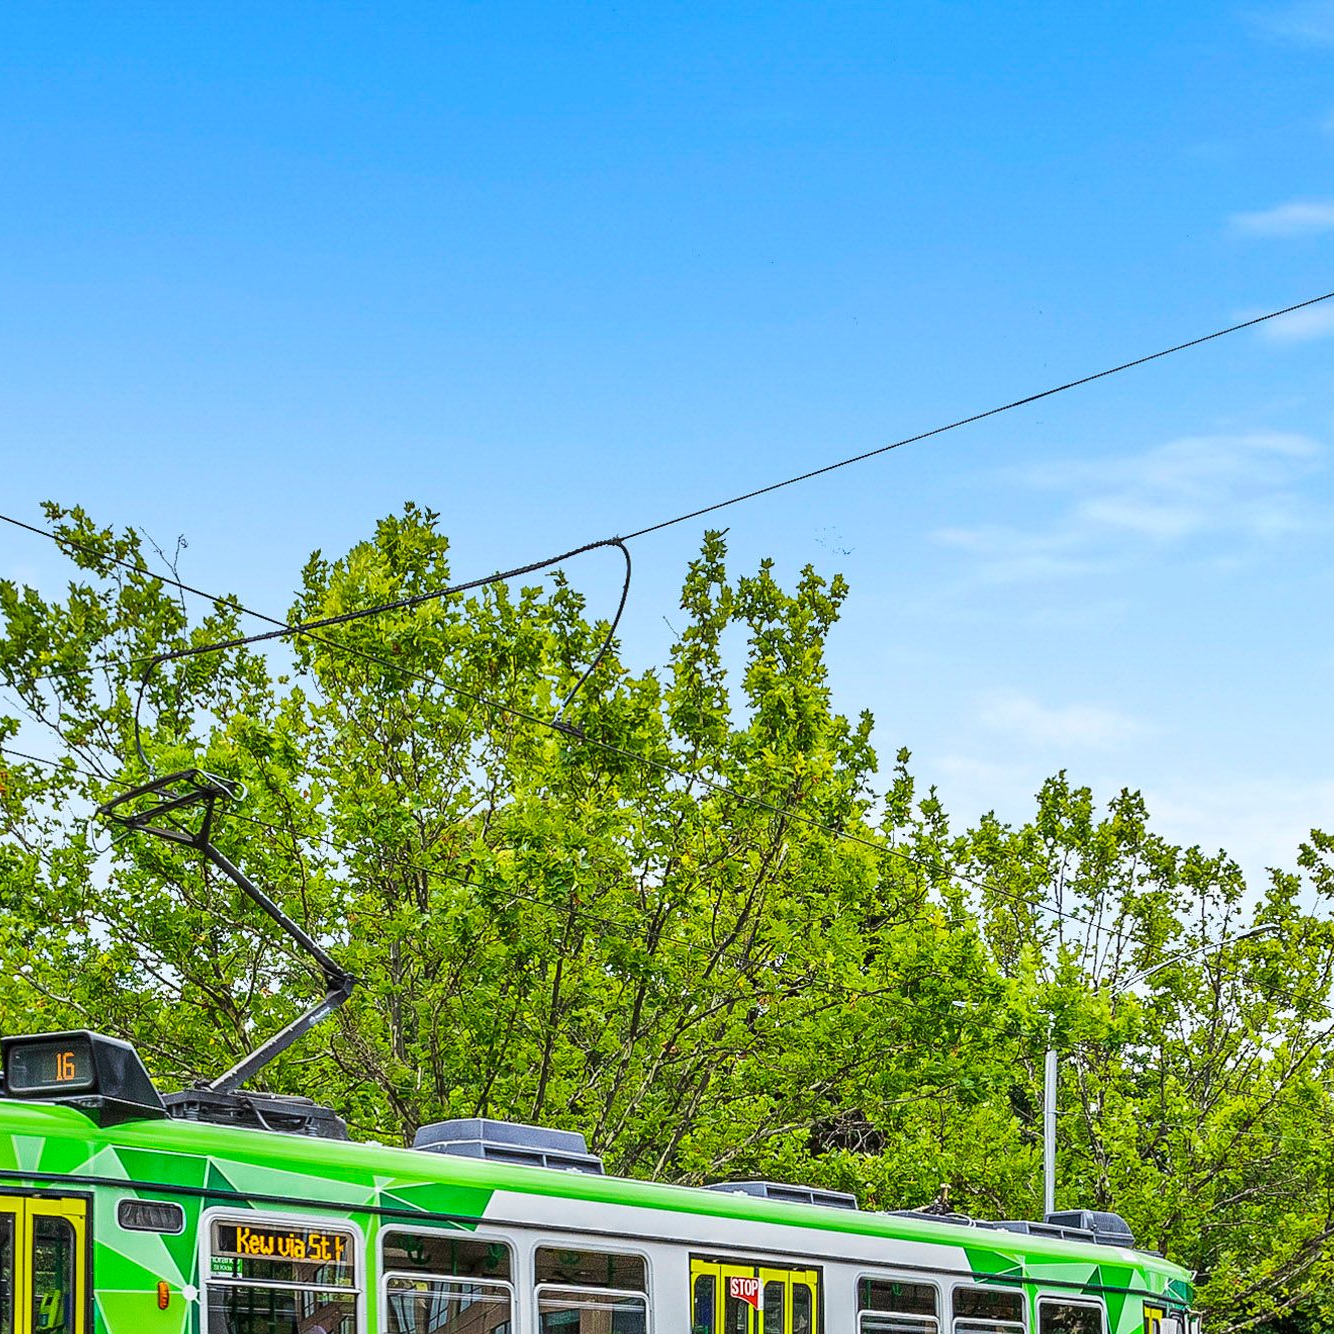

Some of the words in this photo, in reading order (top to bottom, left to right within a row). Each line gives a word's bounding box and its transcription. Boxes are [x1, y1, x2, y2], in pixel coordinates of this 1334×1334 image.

[56, 1051, 76, 1081] 16
[236, 1226, 275, 1256] Kew
[277, 1233, 306, 1259] via
[308, 1233, 332, 1260] St
[730, 1278, 758, 1297] STOP
